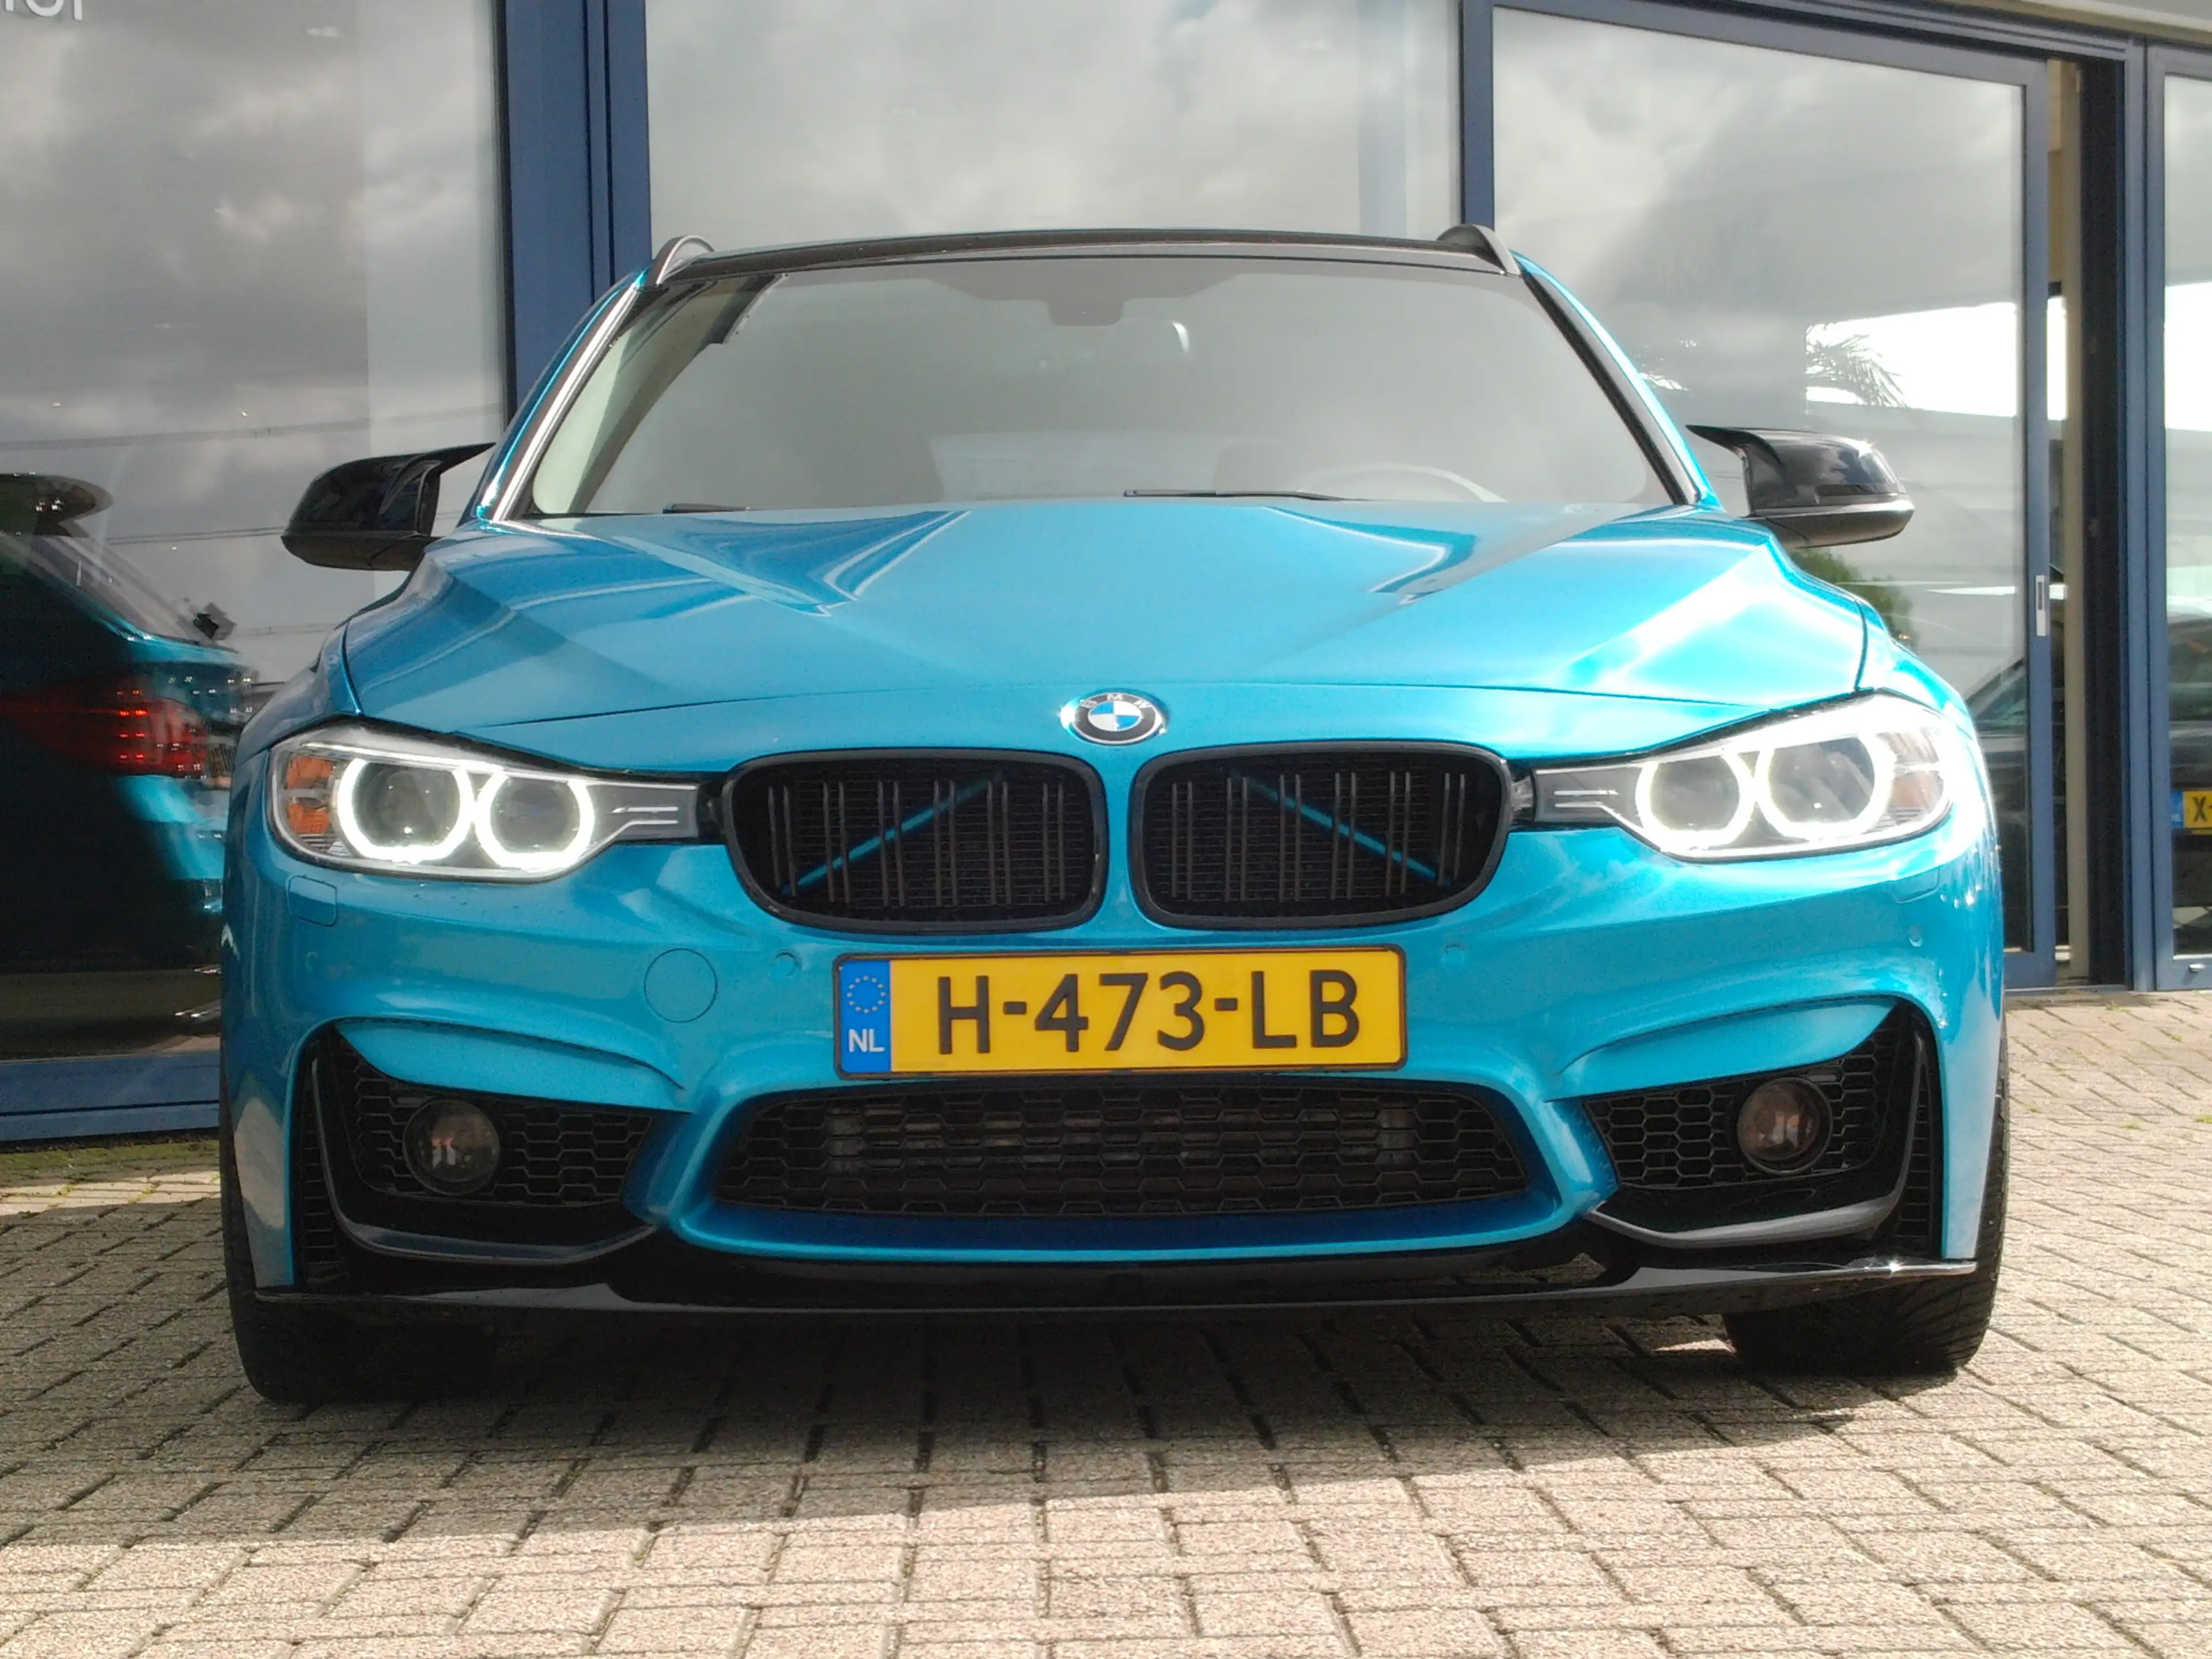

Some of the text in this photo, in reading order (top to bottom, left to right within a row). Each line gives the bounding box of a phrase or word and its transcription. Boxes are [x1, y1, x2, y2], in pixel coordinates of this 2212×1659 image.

[1080, 693, 1153, 709] BMW
[937, 969, 1359, 1055] H-473-LB
[848, 1028, 885, 1053] NL
